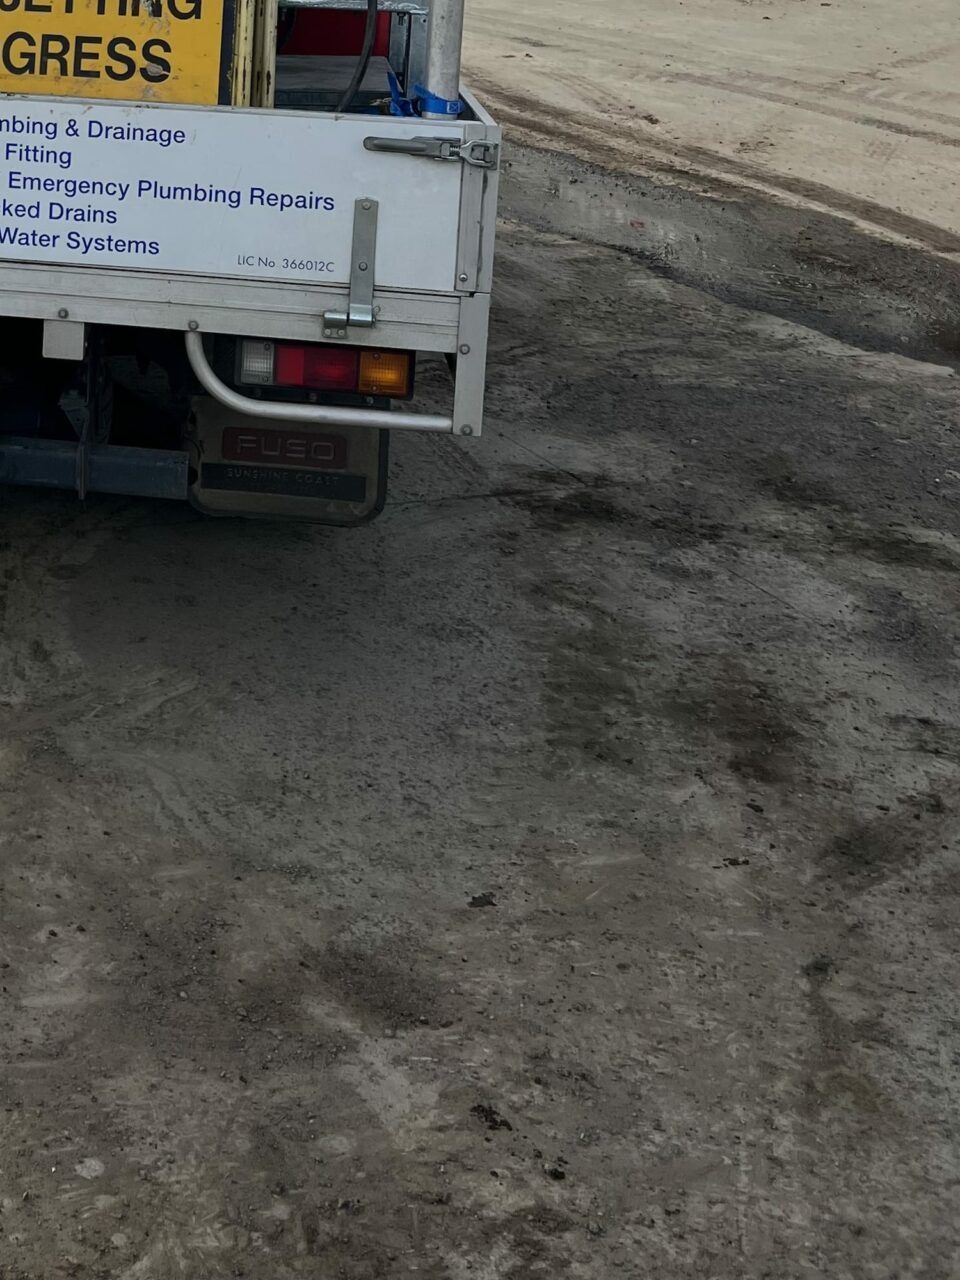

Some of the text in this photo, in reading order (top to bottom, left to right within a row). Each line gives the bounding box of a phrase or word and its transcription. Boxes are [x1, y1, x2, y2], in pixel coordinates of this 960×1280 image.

[65, 119, 80, 137] &
[88, 120, 186, 147] Drainage
[5, 143, 72, 169] Fitting
[8, 171, 130, 201] Emergency
[138, 179, 241, 209] Plumbing
[250, 187, 335, 211] Repairs
[48, 202, 118, 224] Drains
[66, 231, 160, 255] Systems
[237, 254, 335, 272] LIC No 366012C
[237, 435, 335, 460] FUSO
[227, 468, 339, 486] SUNSHINE COAST
